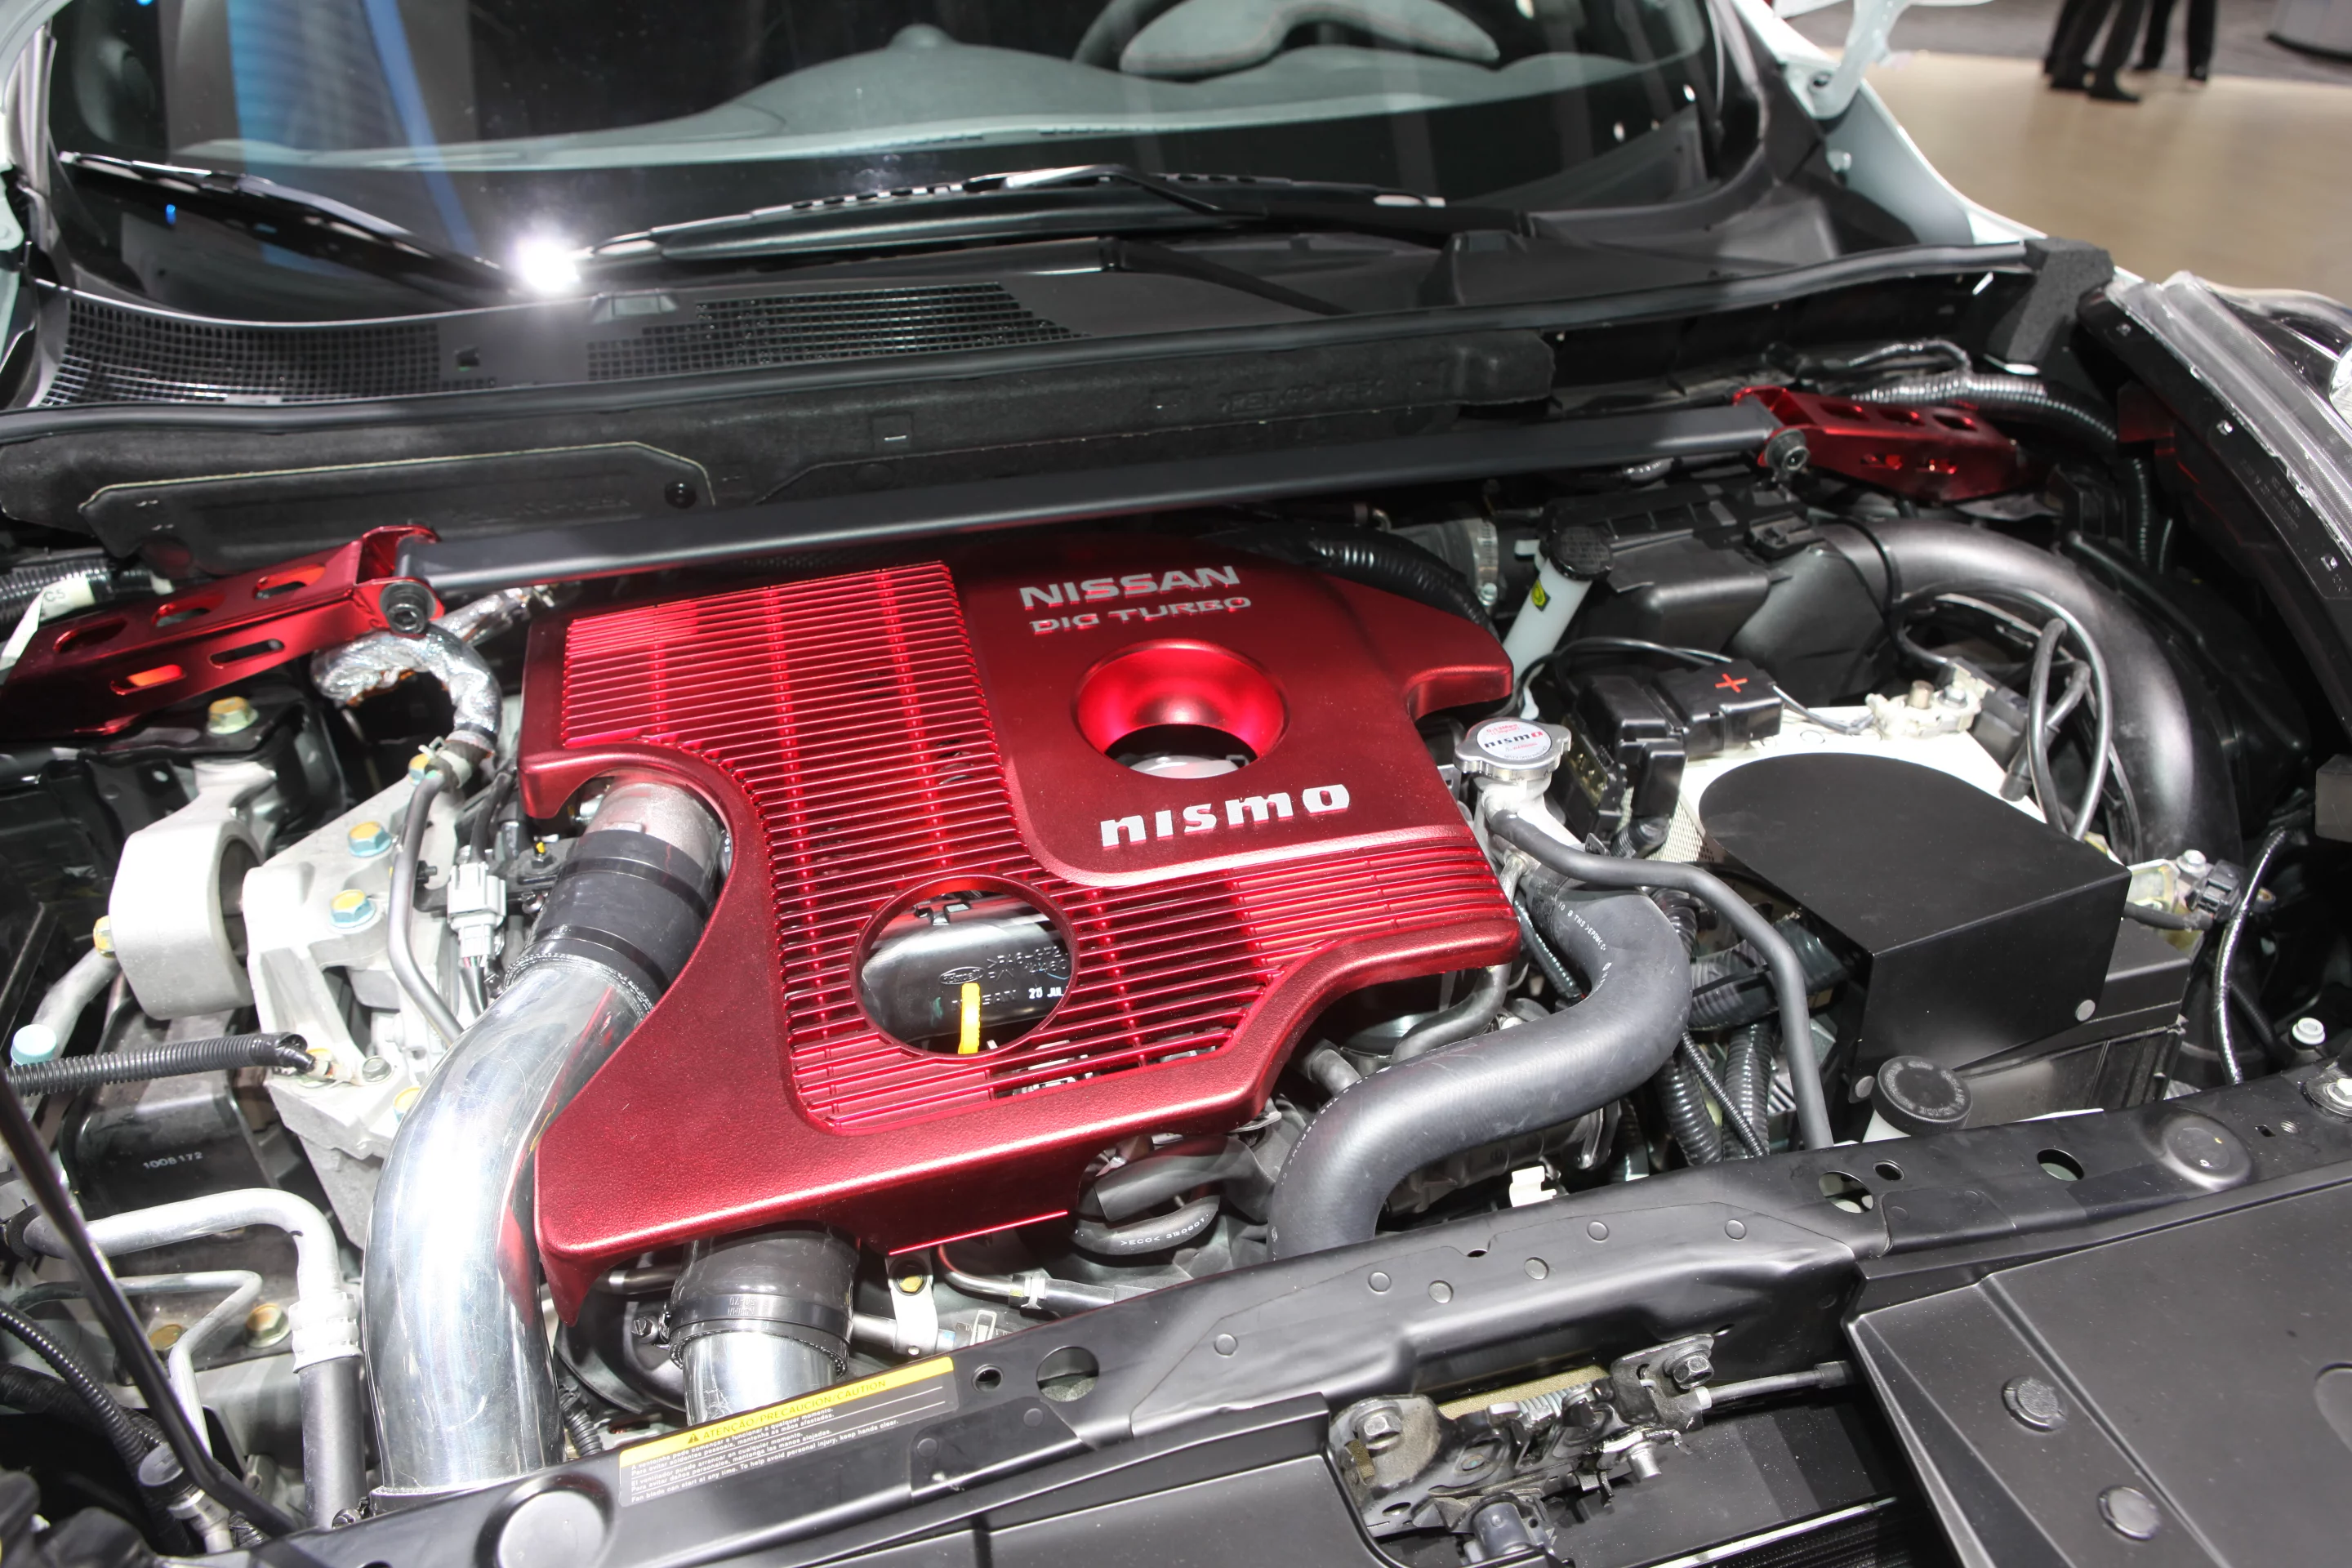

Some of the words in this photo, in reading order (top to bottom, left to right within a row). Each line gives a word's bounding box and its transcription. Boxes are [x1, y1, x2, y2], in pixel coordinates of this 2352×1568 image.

[1019, 565, 1241, 610] NISSAN
[1108, 596, 1252, 624] TURBO
[1484, 730, 1544, 749] nismo
[1100, 784, 1351, 847] nismo
